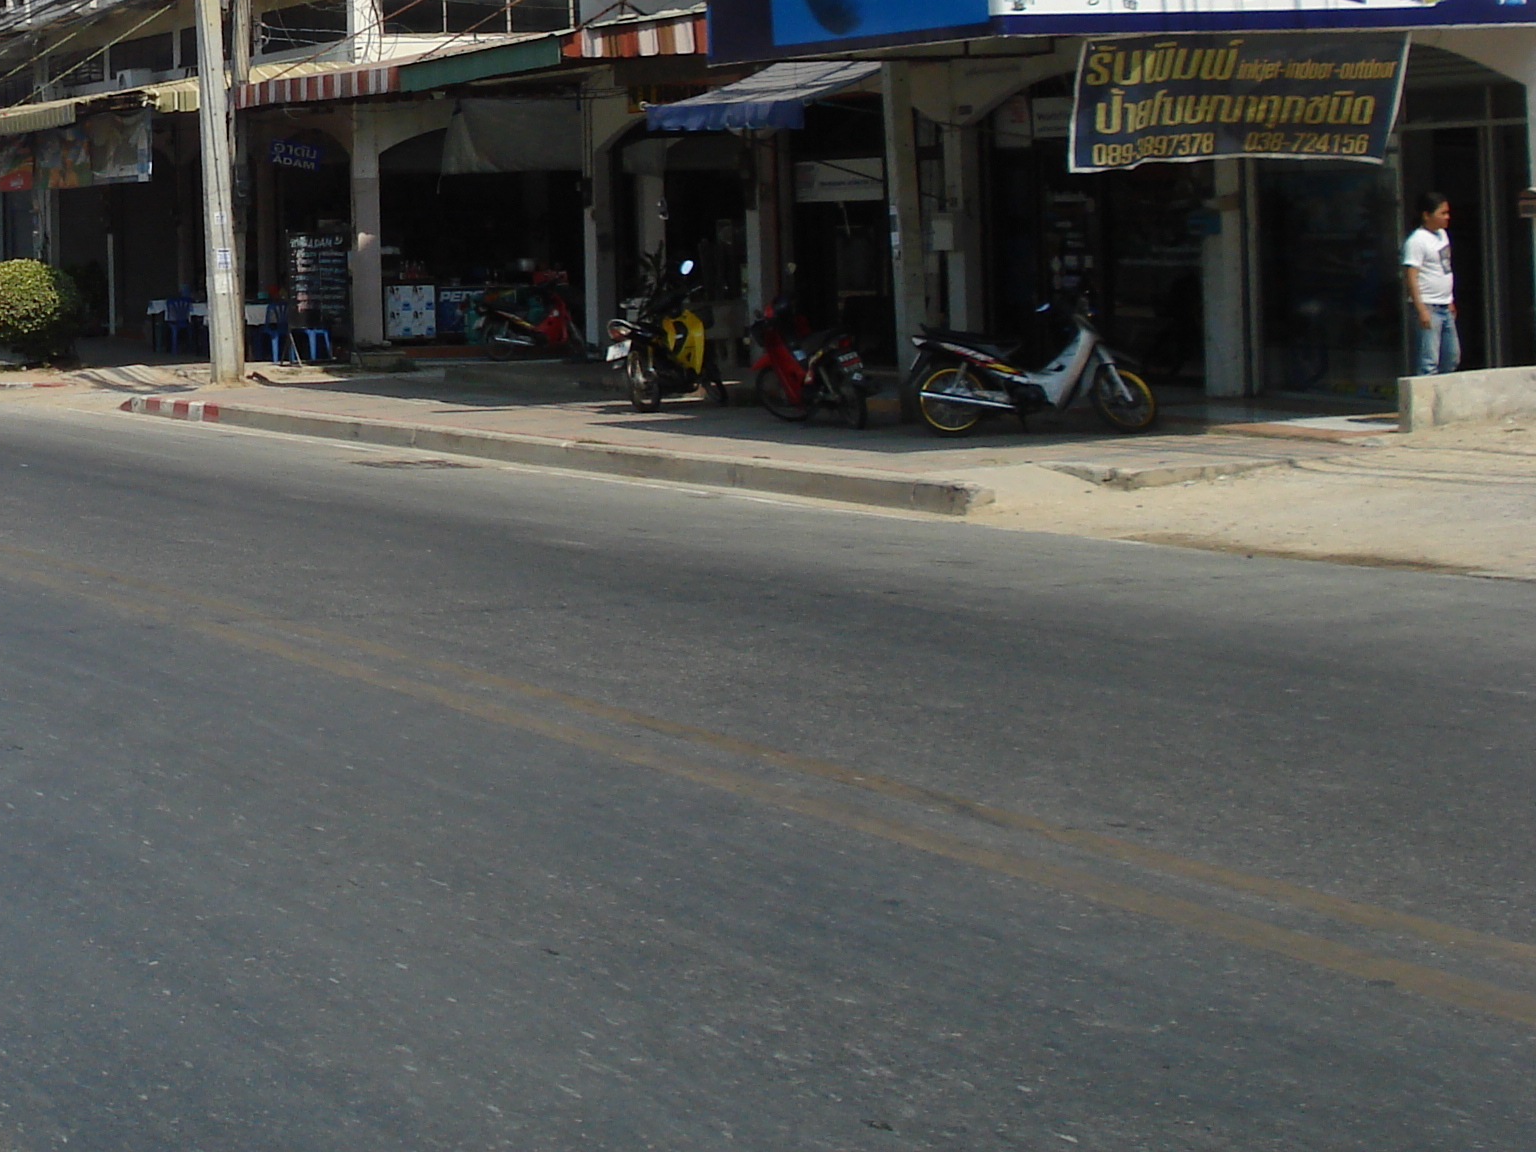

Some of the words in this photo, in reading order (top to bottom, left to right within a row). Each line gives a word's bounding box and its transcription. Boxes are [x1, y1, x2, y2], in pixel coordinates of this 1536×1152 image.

[1085, 39, 1245, 85] รับพิมพ์
[1245, 131, 1369, 154] 038-724156
[272, 153, 316, 170] ADAM
